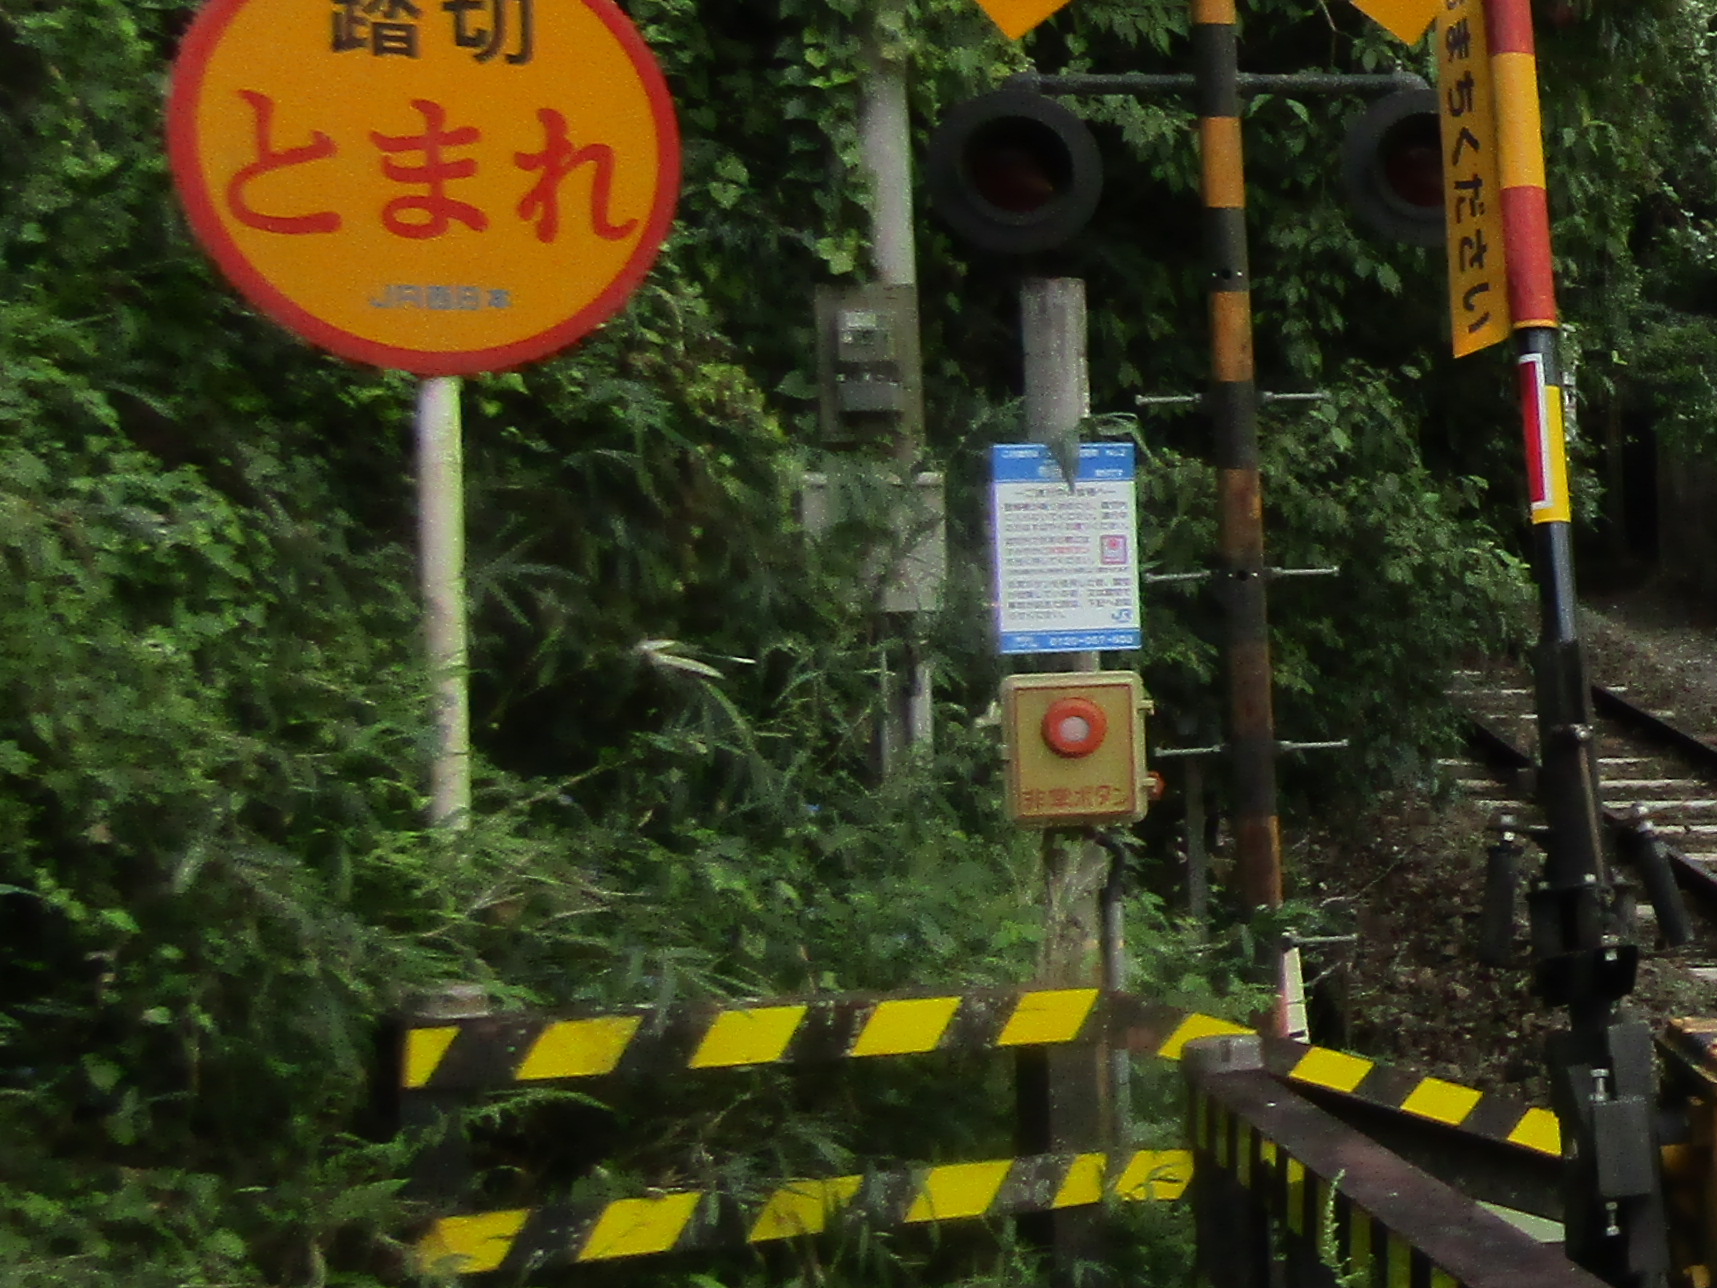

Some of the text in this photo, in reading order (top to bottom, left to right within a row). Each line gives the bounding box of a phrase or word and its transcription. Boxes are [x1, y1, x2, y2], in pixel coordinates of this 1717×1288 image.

[225, 88, 639, 244] とまれ
[369, 285, 513, 311] JR西日本
[1021, 784, 1129, 810] 非常ボタン
